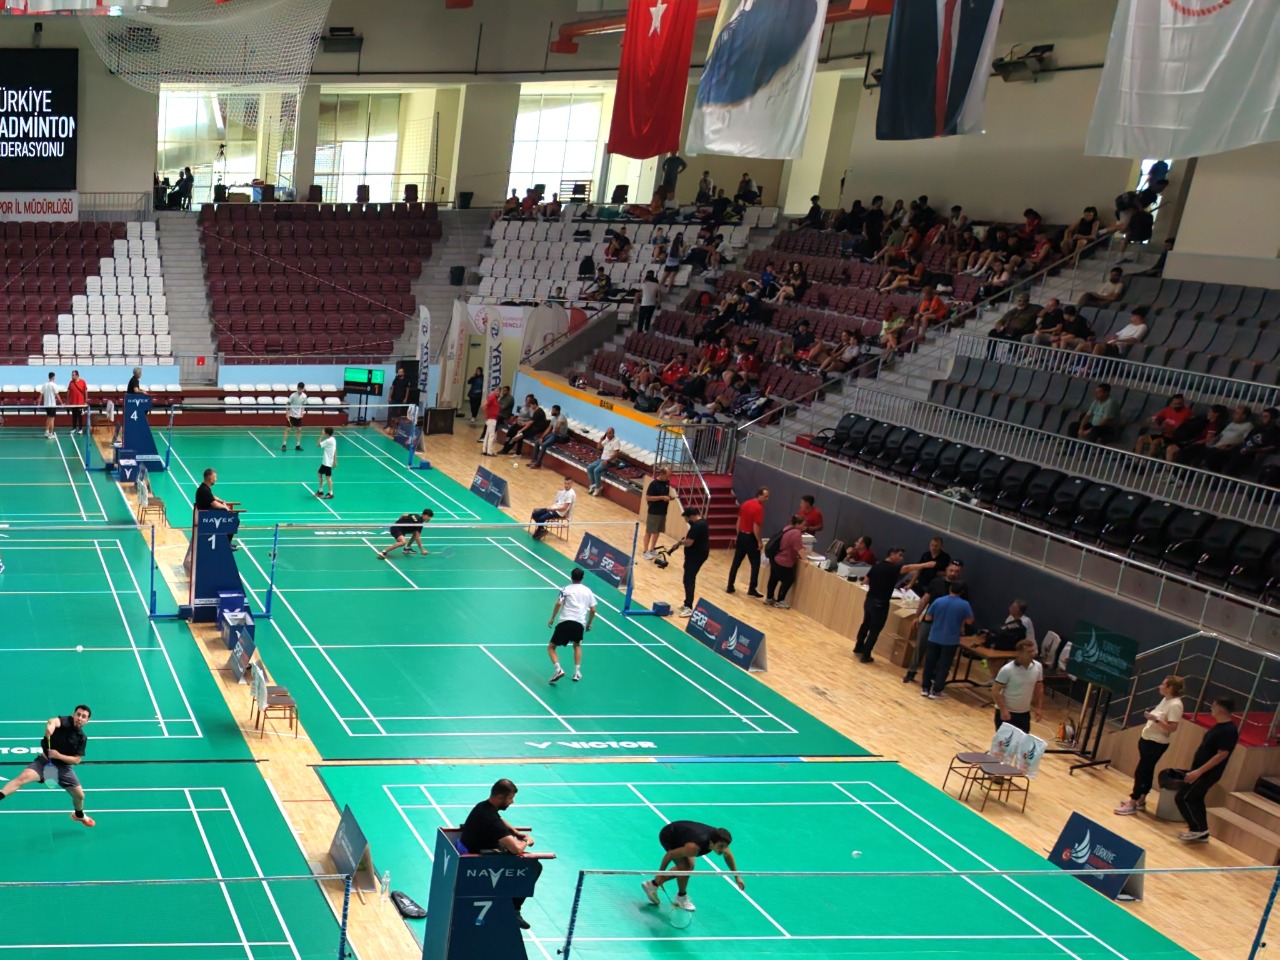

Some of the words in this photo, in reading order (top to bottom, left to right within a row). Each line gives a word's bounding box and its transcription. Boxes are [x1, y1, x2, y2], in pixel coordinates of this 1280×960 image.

[24, 198, 73, 214] MÜDÜRLÜĞÜ
[130, 411, 138, 421] 4
[203, 517, 233, 529] NAVEK
[208, 534, 216, 550] 1
[556, 741, 658, 749] VICTOR
[467, 867, 526, 888] NAVEK
[473, 901, 493, 926] 7
